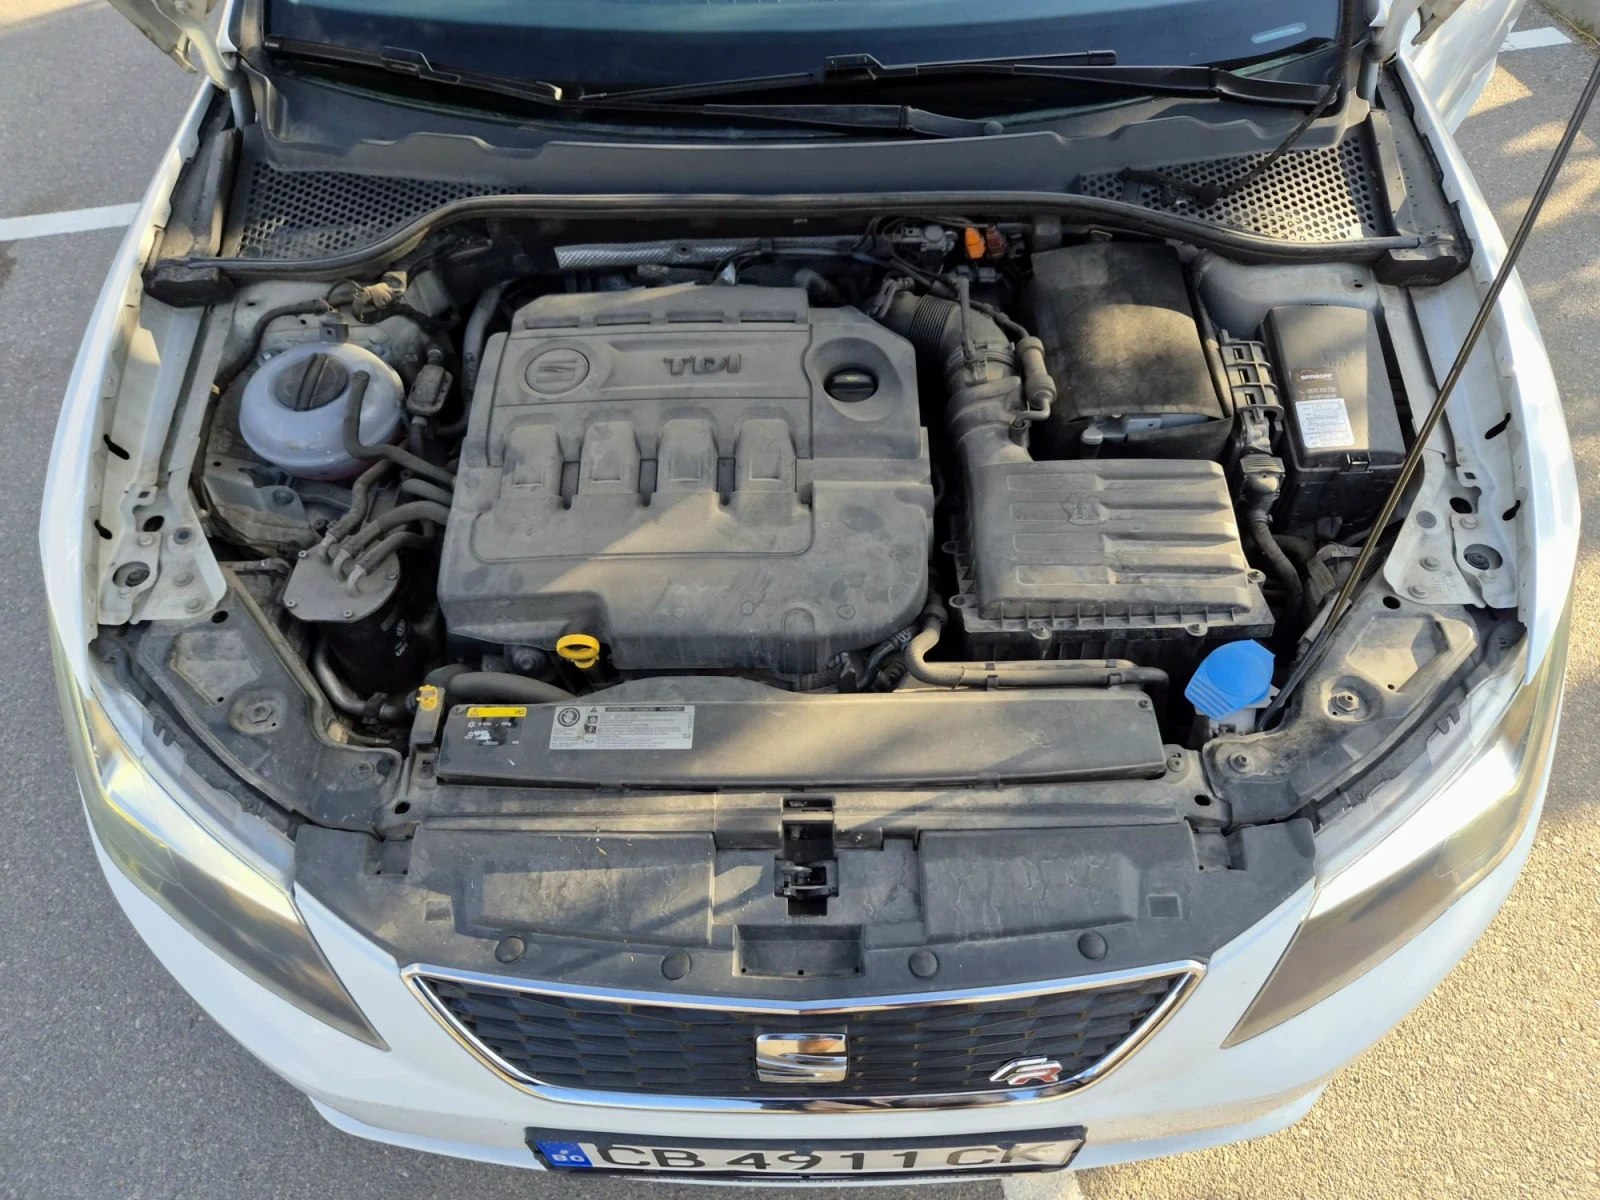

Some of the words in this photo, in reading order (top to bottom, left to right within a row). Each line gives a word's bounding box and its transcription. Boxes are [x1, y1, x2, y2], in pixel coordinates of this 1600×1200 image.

[663, 354, 742, 376] TDI
[551, 1154, 585, 1162] BG
[597, 1146, 706, 1168] CB
[726, 1151, 918, 1170] 4911
[947, 1144, 1056, 1166] CK
